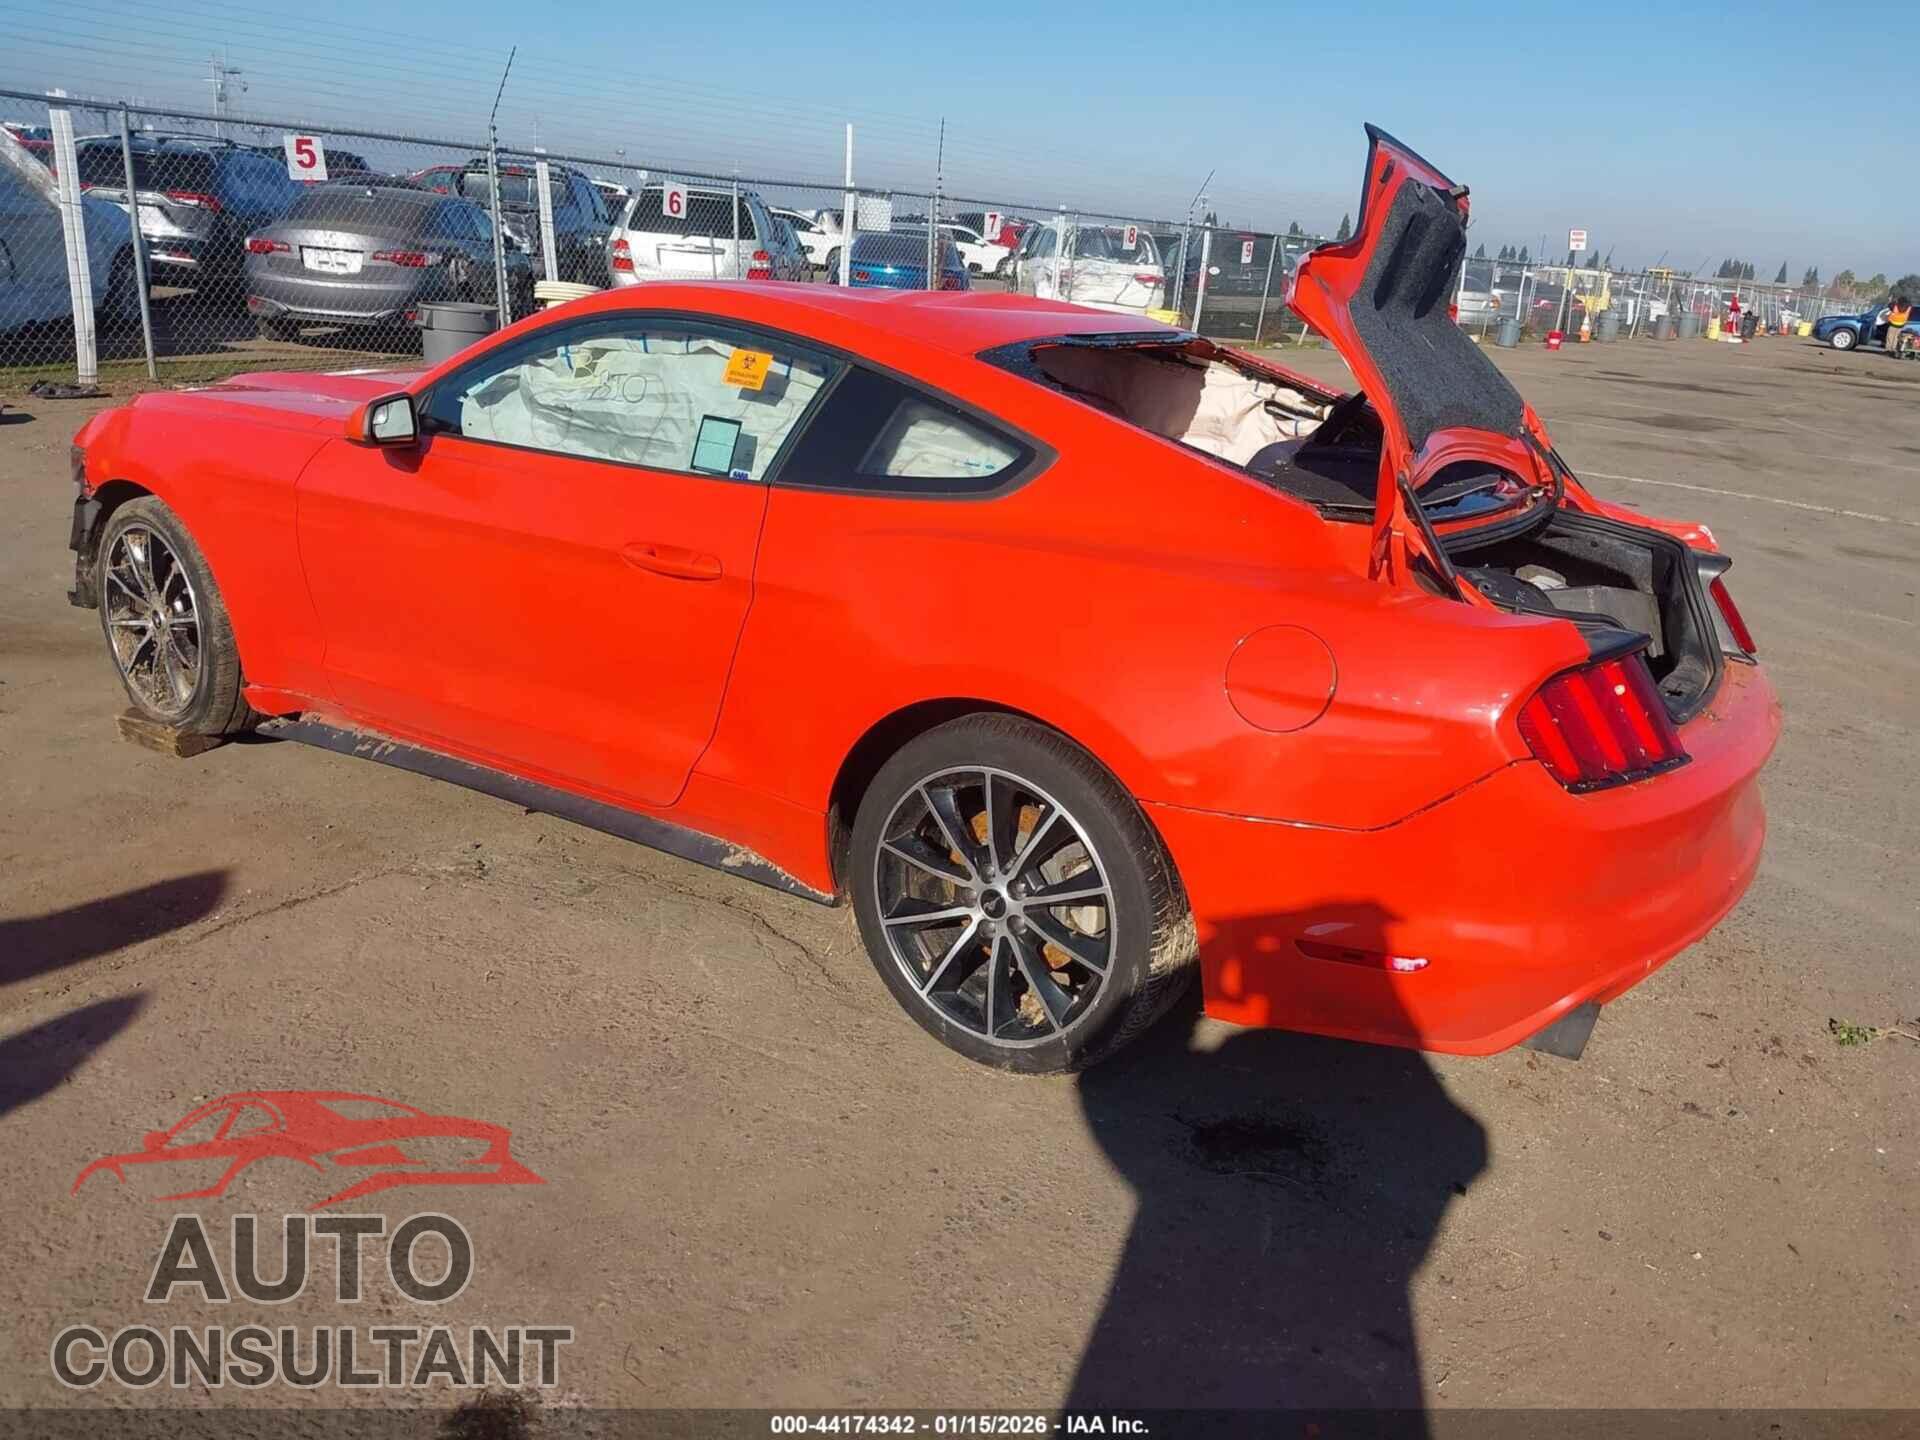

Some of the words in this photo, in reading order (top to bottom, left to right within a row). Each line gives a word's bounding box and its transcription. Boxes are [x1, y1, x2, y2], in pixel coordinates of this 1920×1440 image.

[296, 138, 317, 169] 5
[669, 191, 681, 214] 6
[989, 213, 998, 233] 7
[1128, 227, 1137, 244] 8
[1246, 243, 1253, 257] 9
